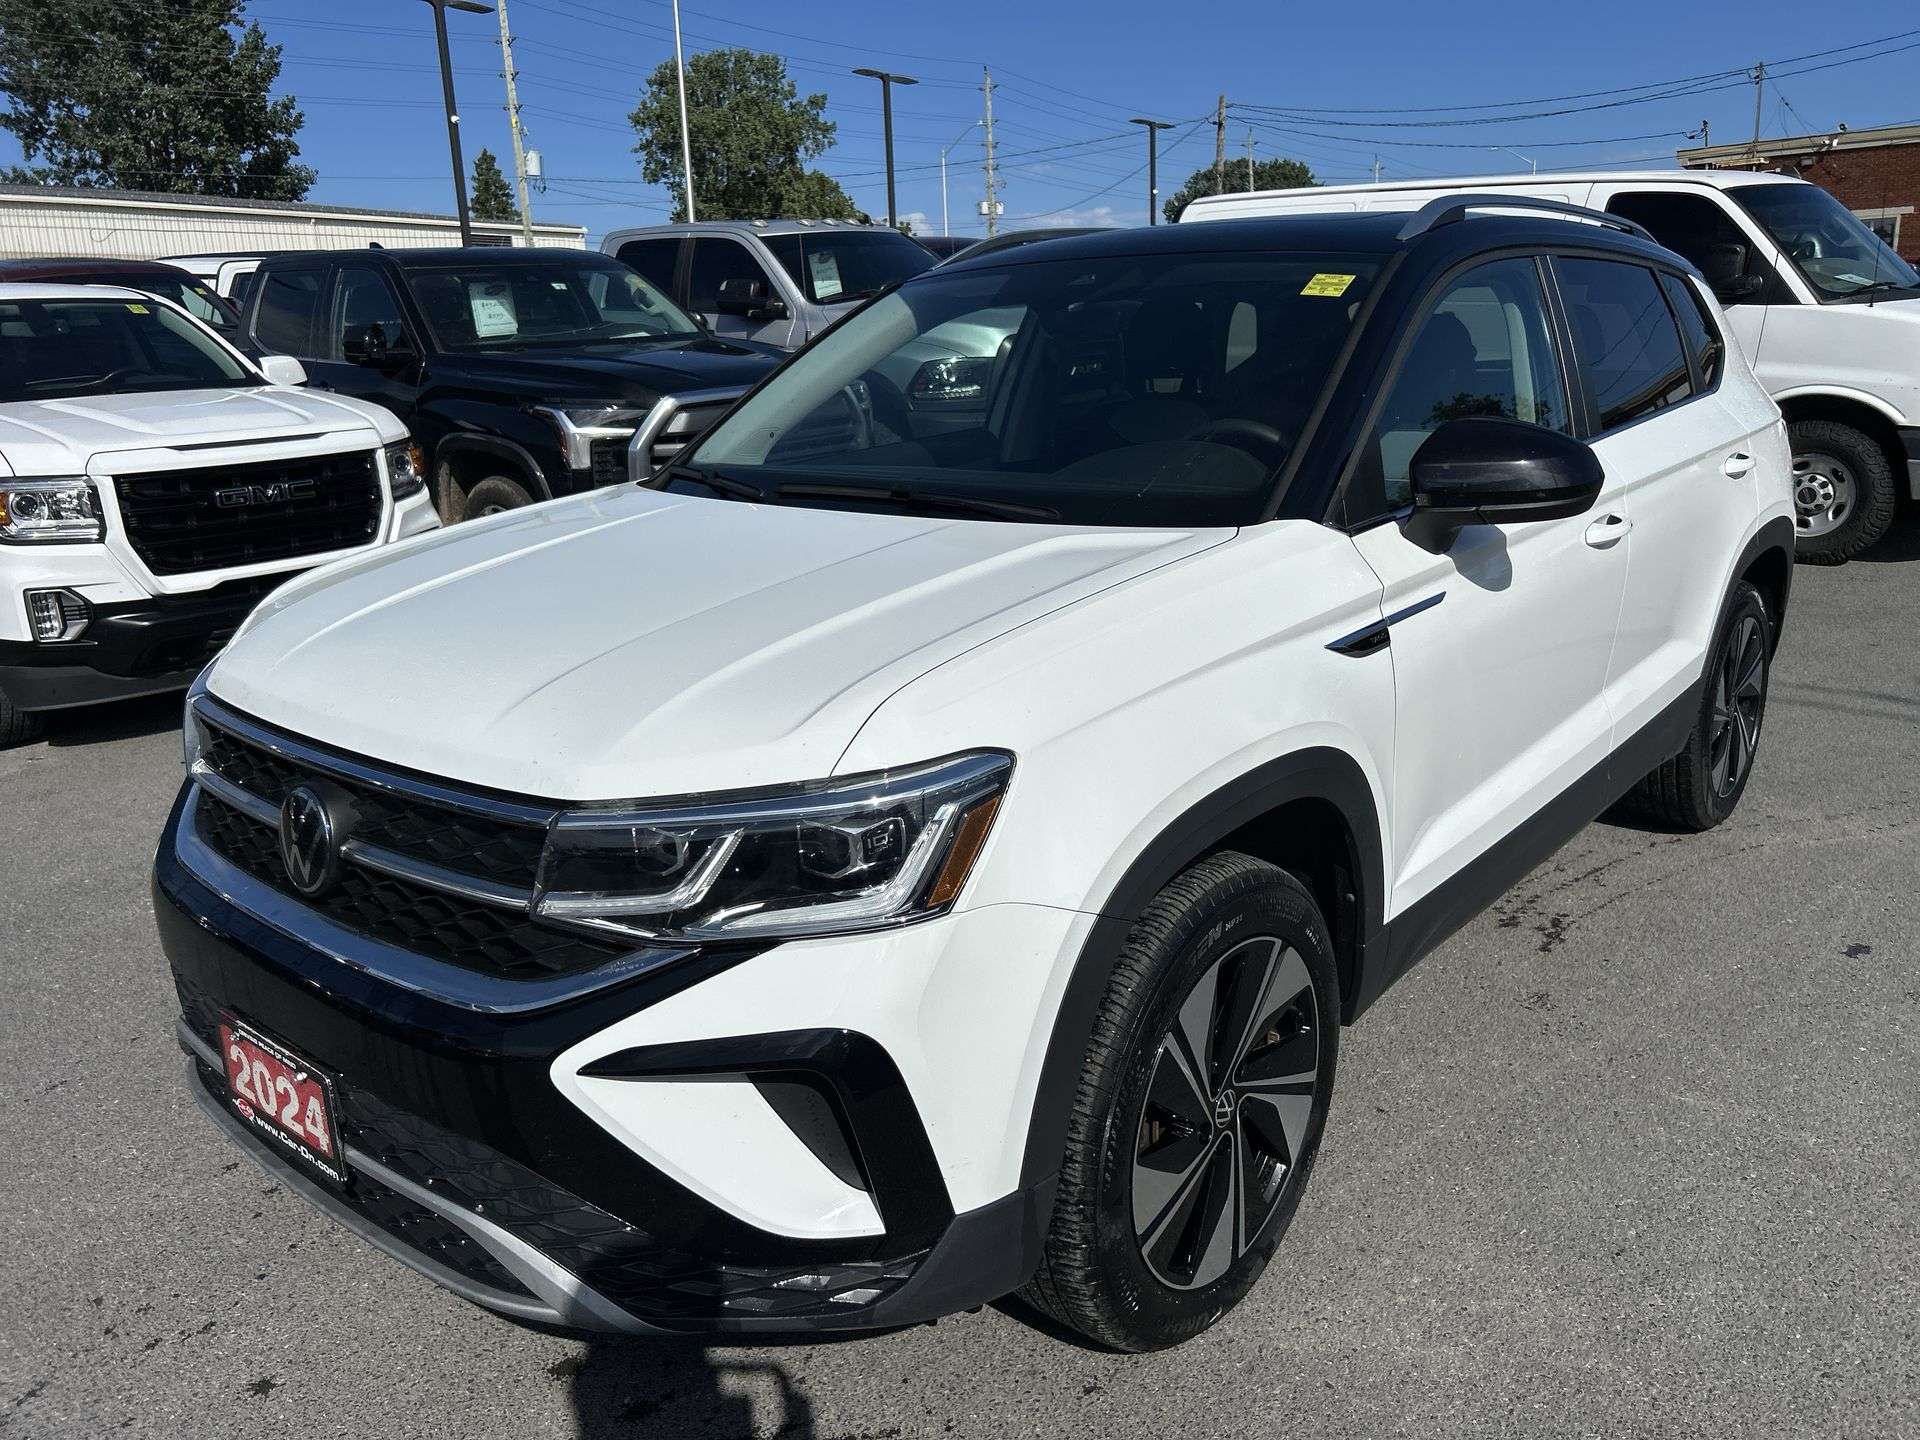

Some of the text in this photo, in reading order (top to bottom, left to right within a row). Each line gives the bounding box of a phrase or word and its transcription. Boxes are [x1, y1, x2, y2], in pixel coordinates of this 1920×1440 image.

[216, 479, 316, 508] GMC
[230, 1044, 330, 1152] 2024
[256, 1115, 340, 1181] www.Car-On.com
